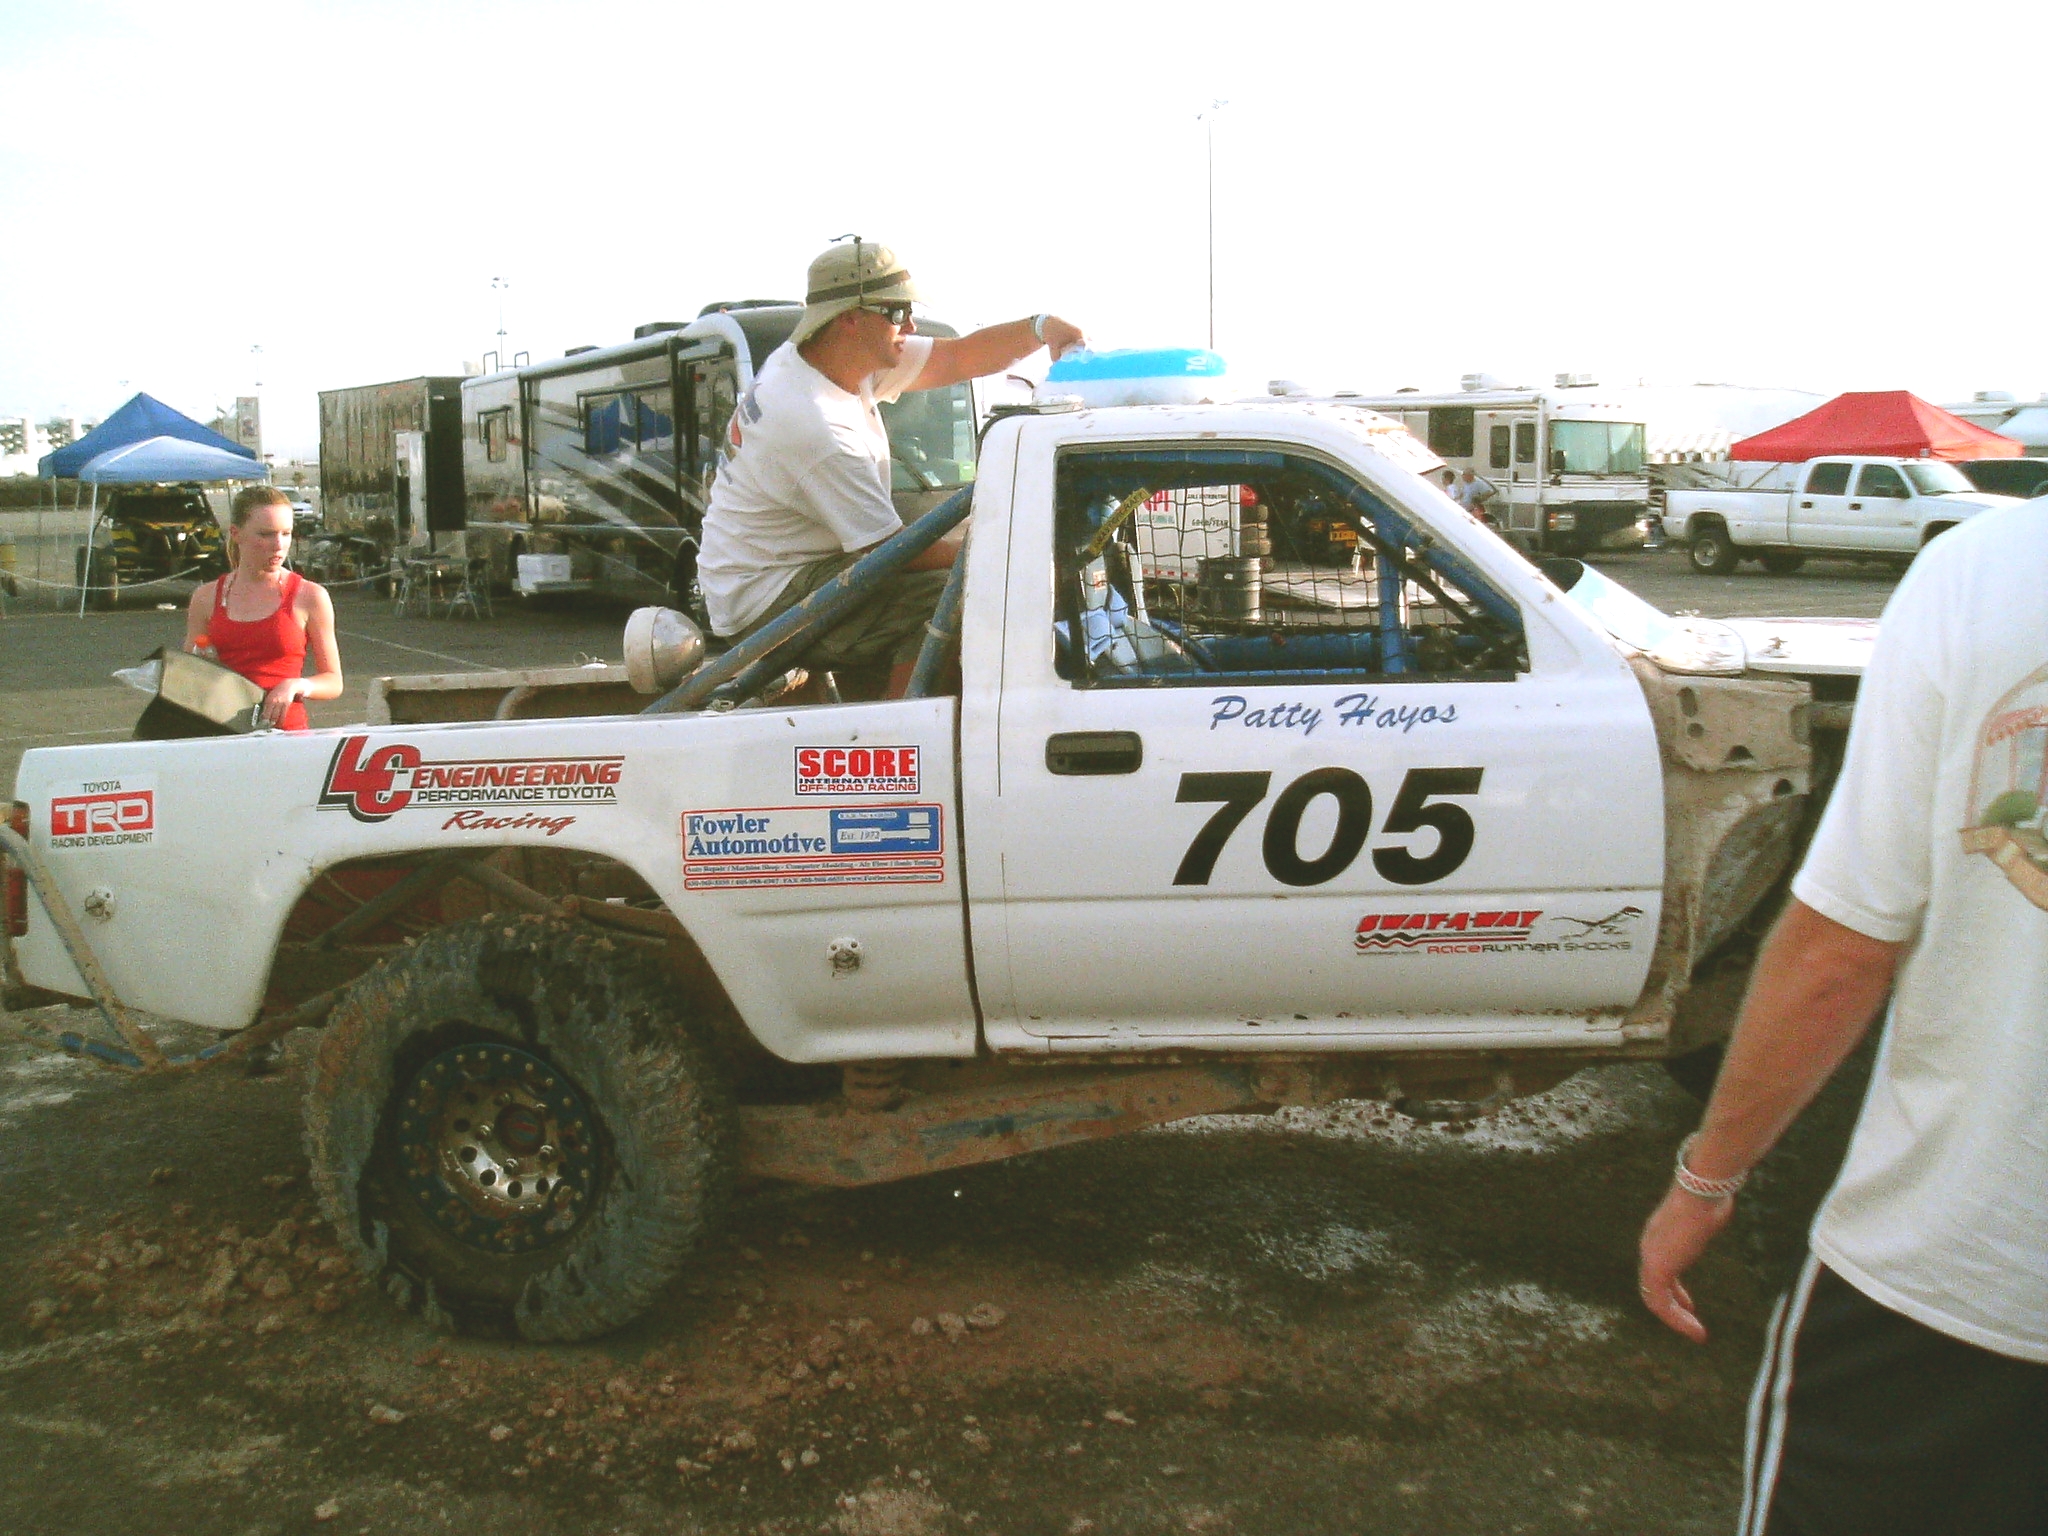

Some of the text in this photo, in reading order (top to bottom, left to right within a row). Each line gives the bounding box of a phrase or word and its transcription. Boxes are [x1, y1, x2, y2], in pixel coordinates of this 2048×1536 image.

[1210, 693, 1460, 736] Patty Hayos
[799, 749, 917, 777] SCORE
[82, 780, 122, 794] TOYOTA
[410, 763, 625, 789] ENGINEERING
[799, 776, 917, 785] INTERNATIONAL
[799, 783, 917, 793] OFF-ROAD RACING
[417, 785, 617, 803] PERFORMANCE TOYOTA
[55, 798, 150, 835] TRD
[441, 810, 577, 837] Racing
[687, 813, 770, 836] Fowler
[1172, 766, 1485, 887] 705
[51, 832, 153, 850] RACING DEVELOPMENT
[688, 832, 827, 856] Automotive
